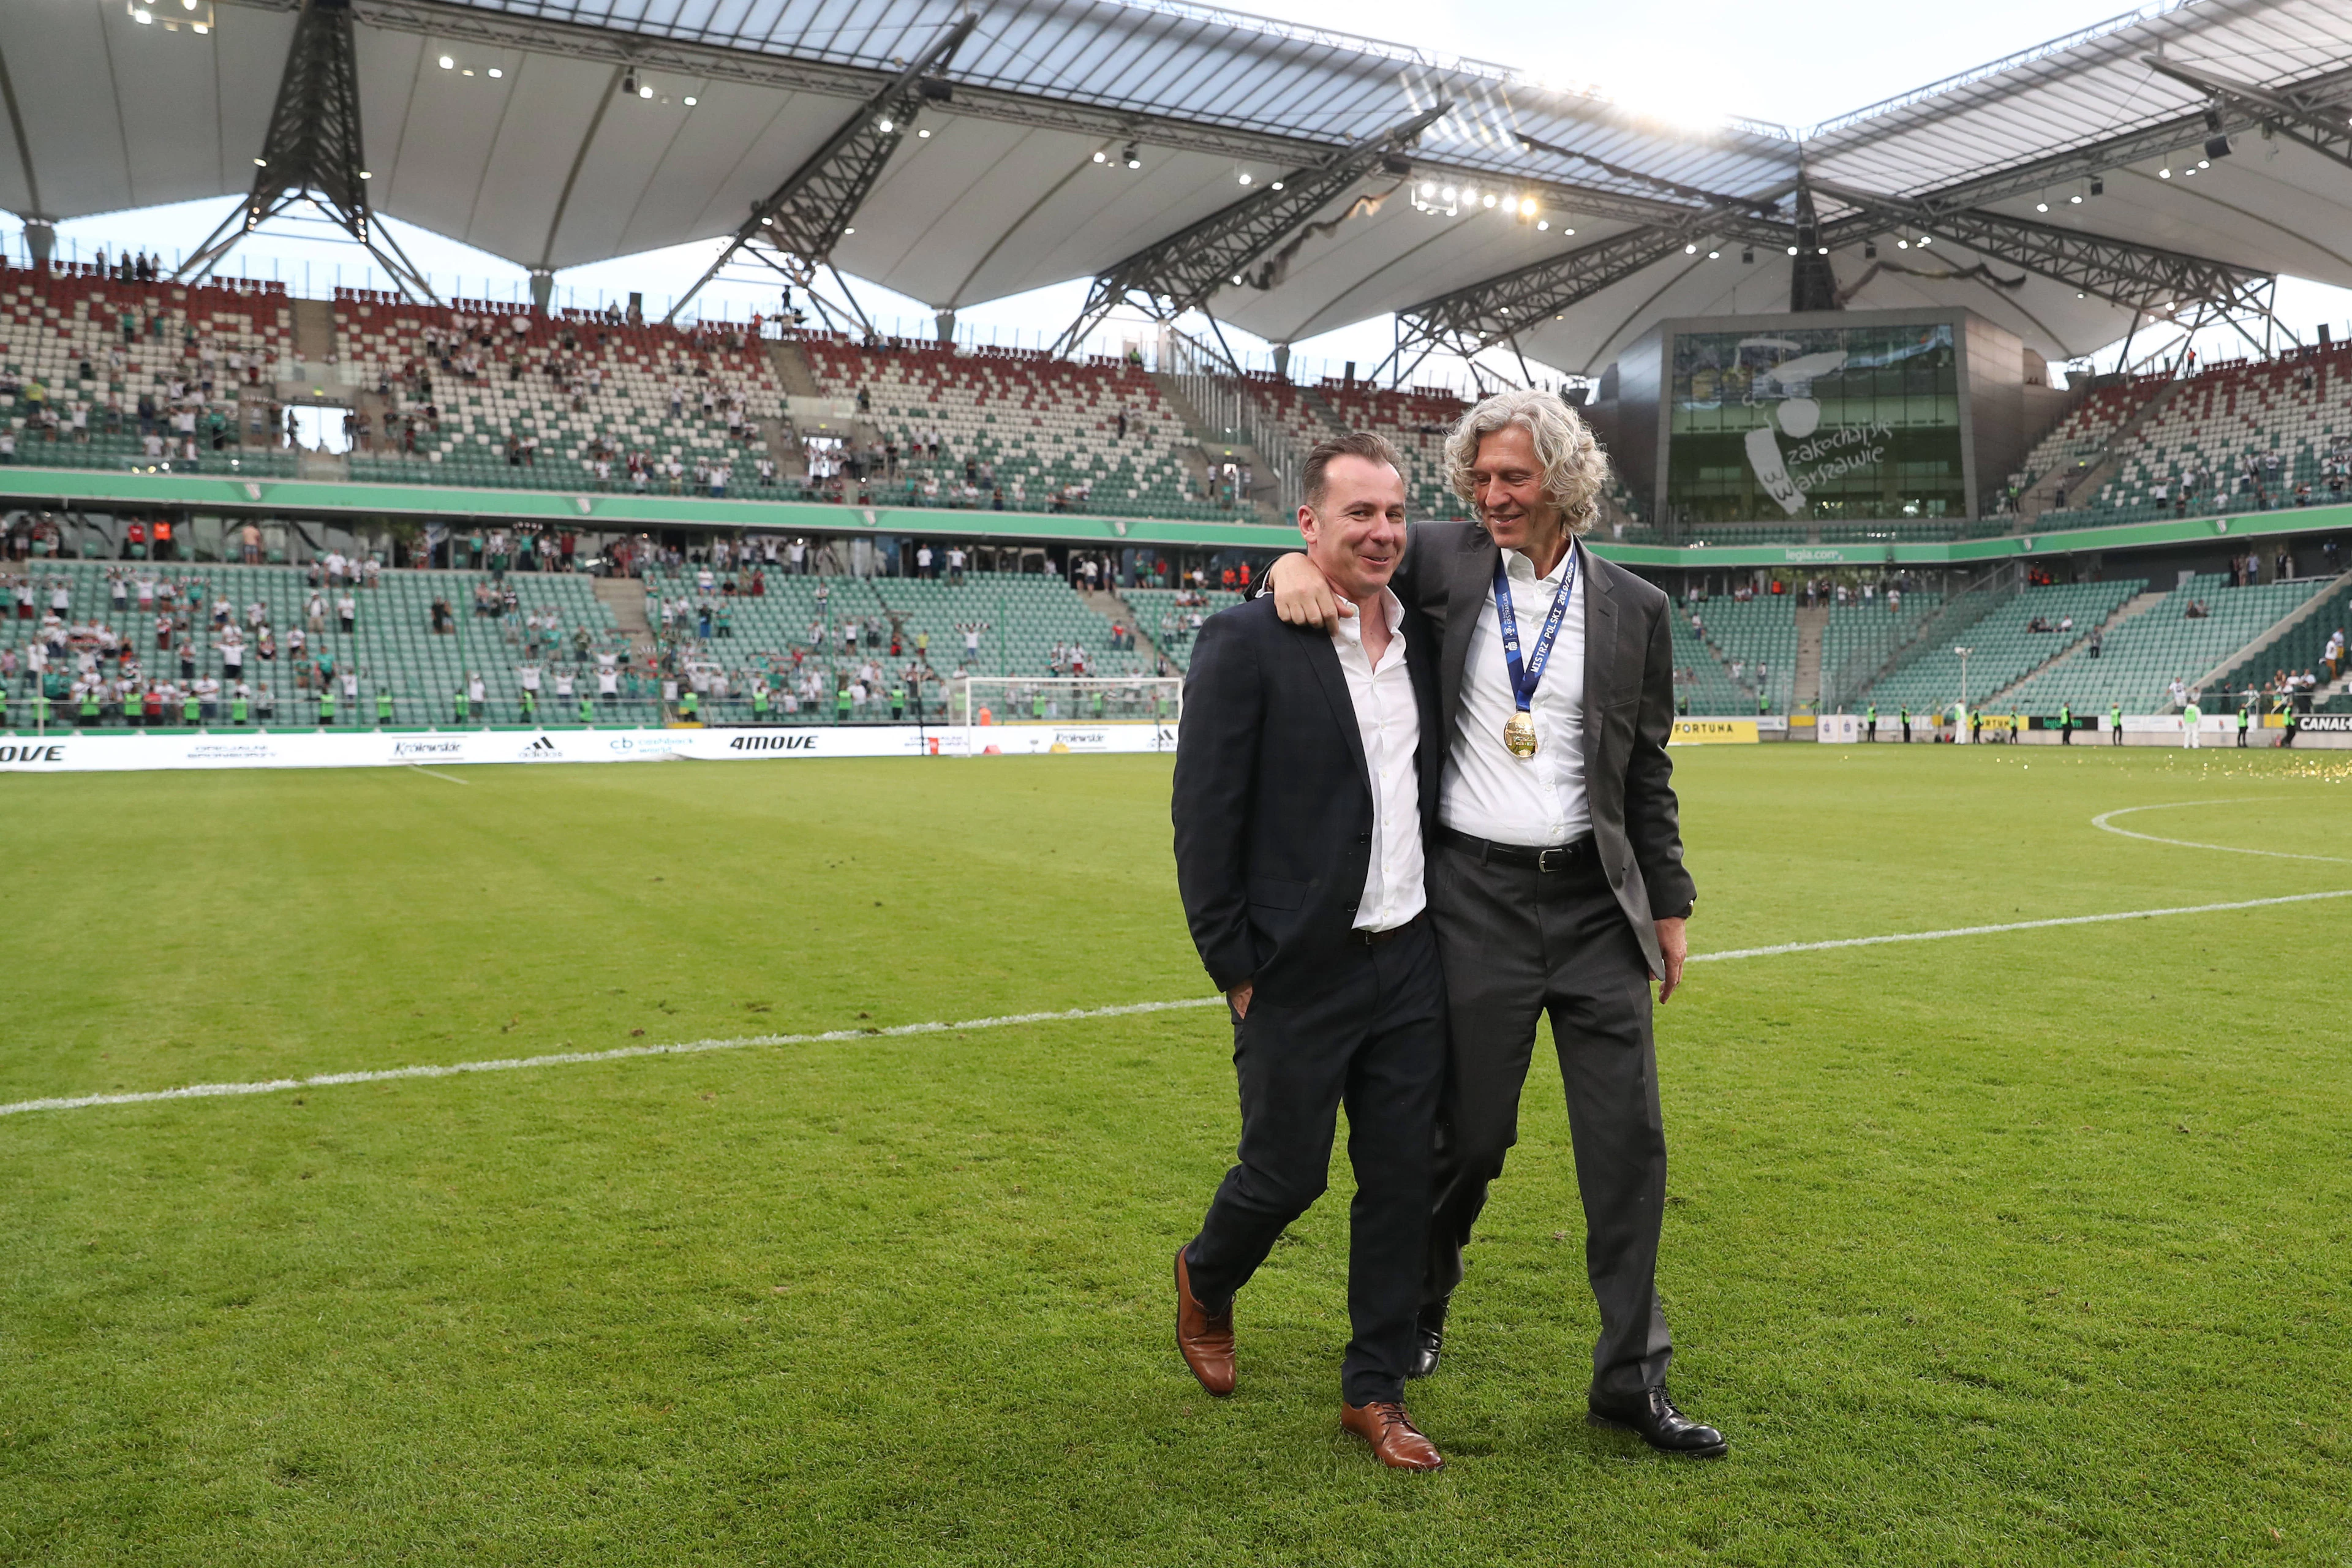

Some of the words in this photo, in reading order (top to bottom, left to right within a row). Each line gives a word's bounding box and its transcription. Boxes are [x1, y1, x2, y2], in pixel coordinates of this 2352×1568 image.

[1787, 418, 1868, 465] zakochaj
[1774, 441, 1885, 501] Warszawie
[1502, 592, 1512, 624] EKSTRAKLASA
[1530, 641, 1549, 673] MISTRZ
[1544, 607, 1562, 639] POLSKI
[1558, 562, 1574, 606] 2019/2020
[610, 737, 633, 749] cb
[730, 736, 818, 750] 4MOVE
[1675, 723, 1733, 734] FORTUNA
